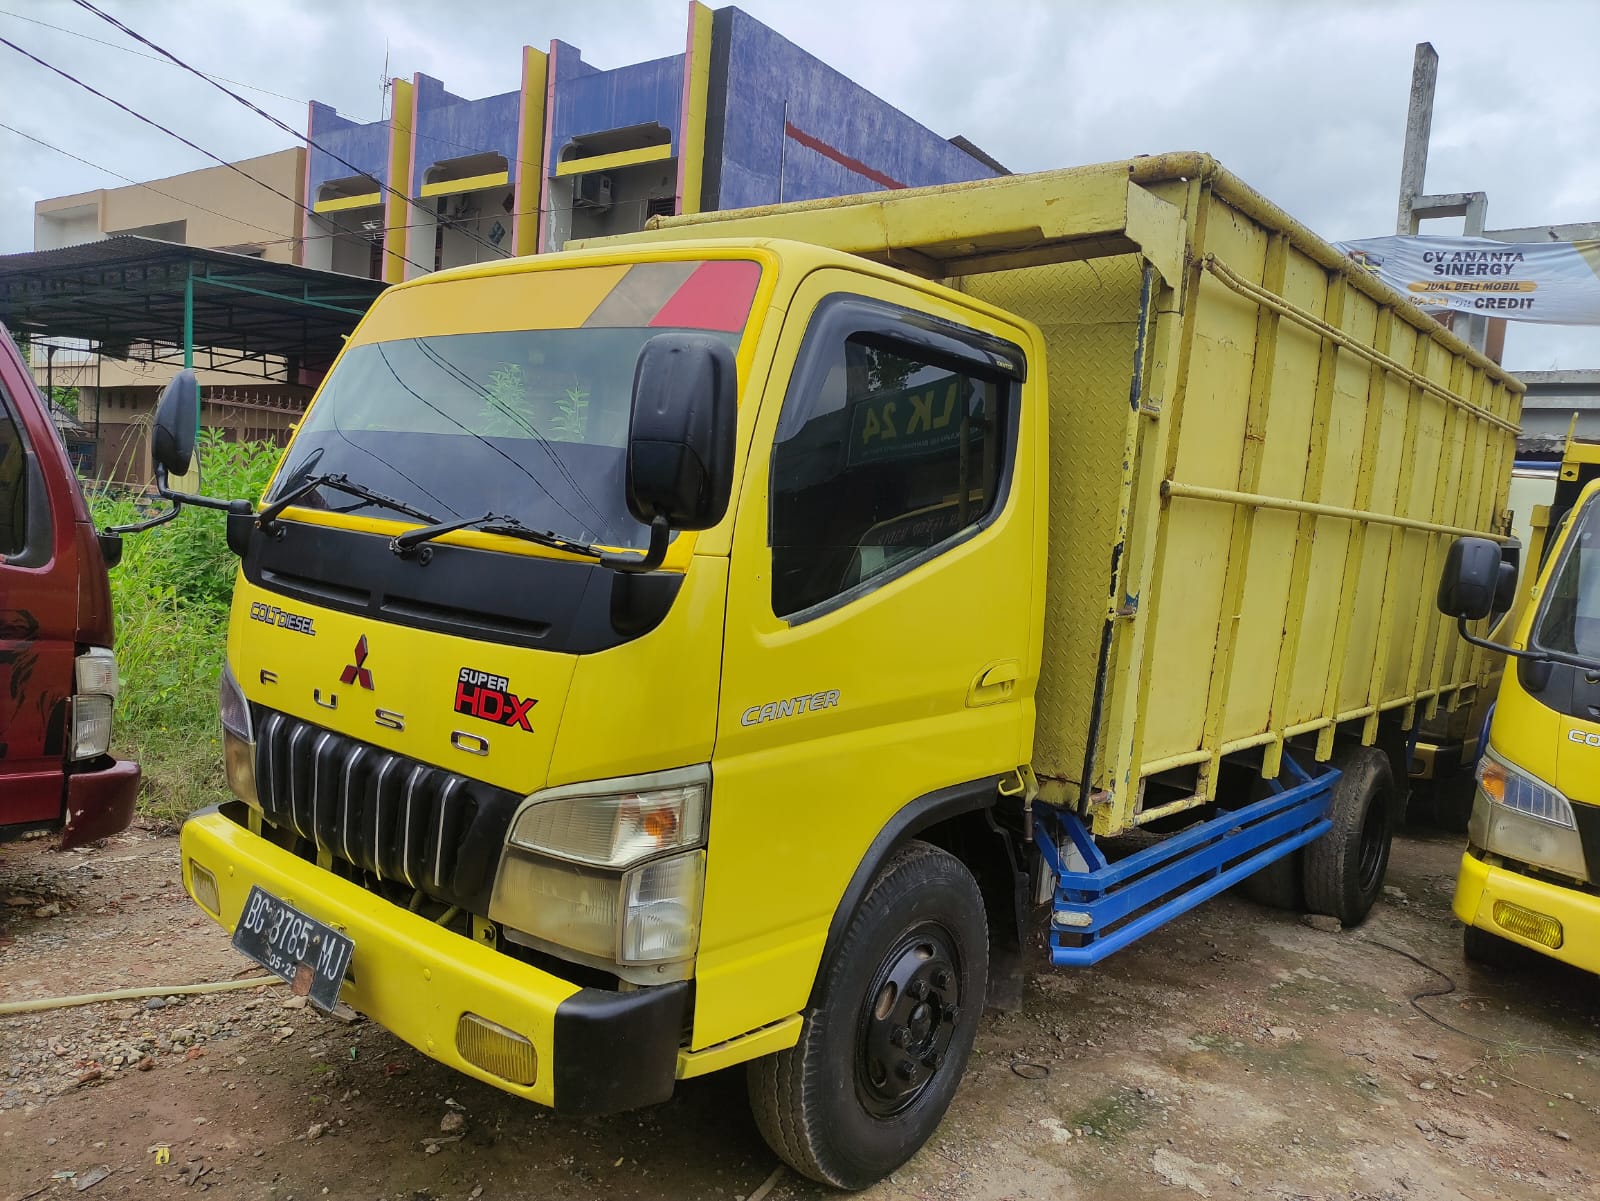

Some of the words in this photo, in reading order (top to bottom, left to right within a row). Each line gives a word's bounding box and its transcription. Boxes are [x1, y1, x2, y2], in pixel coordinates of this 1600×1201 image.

[1423, 252, 1446, 263] CV
[1451, 252, 1524, 263] ANANTA
[1433, 263, 1514, 275] SINERGY
[1424, 282, 1451, 291] JUAL
[1454, 282, 1480, 291] BELI
[1482, 282, 1520, 291] MOBIL
[1474, 298, 1535, 309] CREDIT
[460, 668, 508, 692] SUPER
[260, 669, 490, 757] FUSO
[455, 682, 538, 733] HD-X
[741, 689, 840, 726] CANTER
[244, 893, 270, 934] BG
[316, 934, 346, 981] MJ
